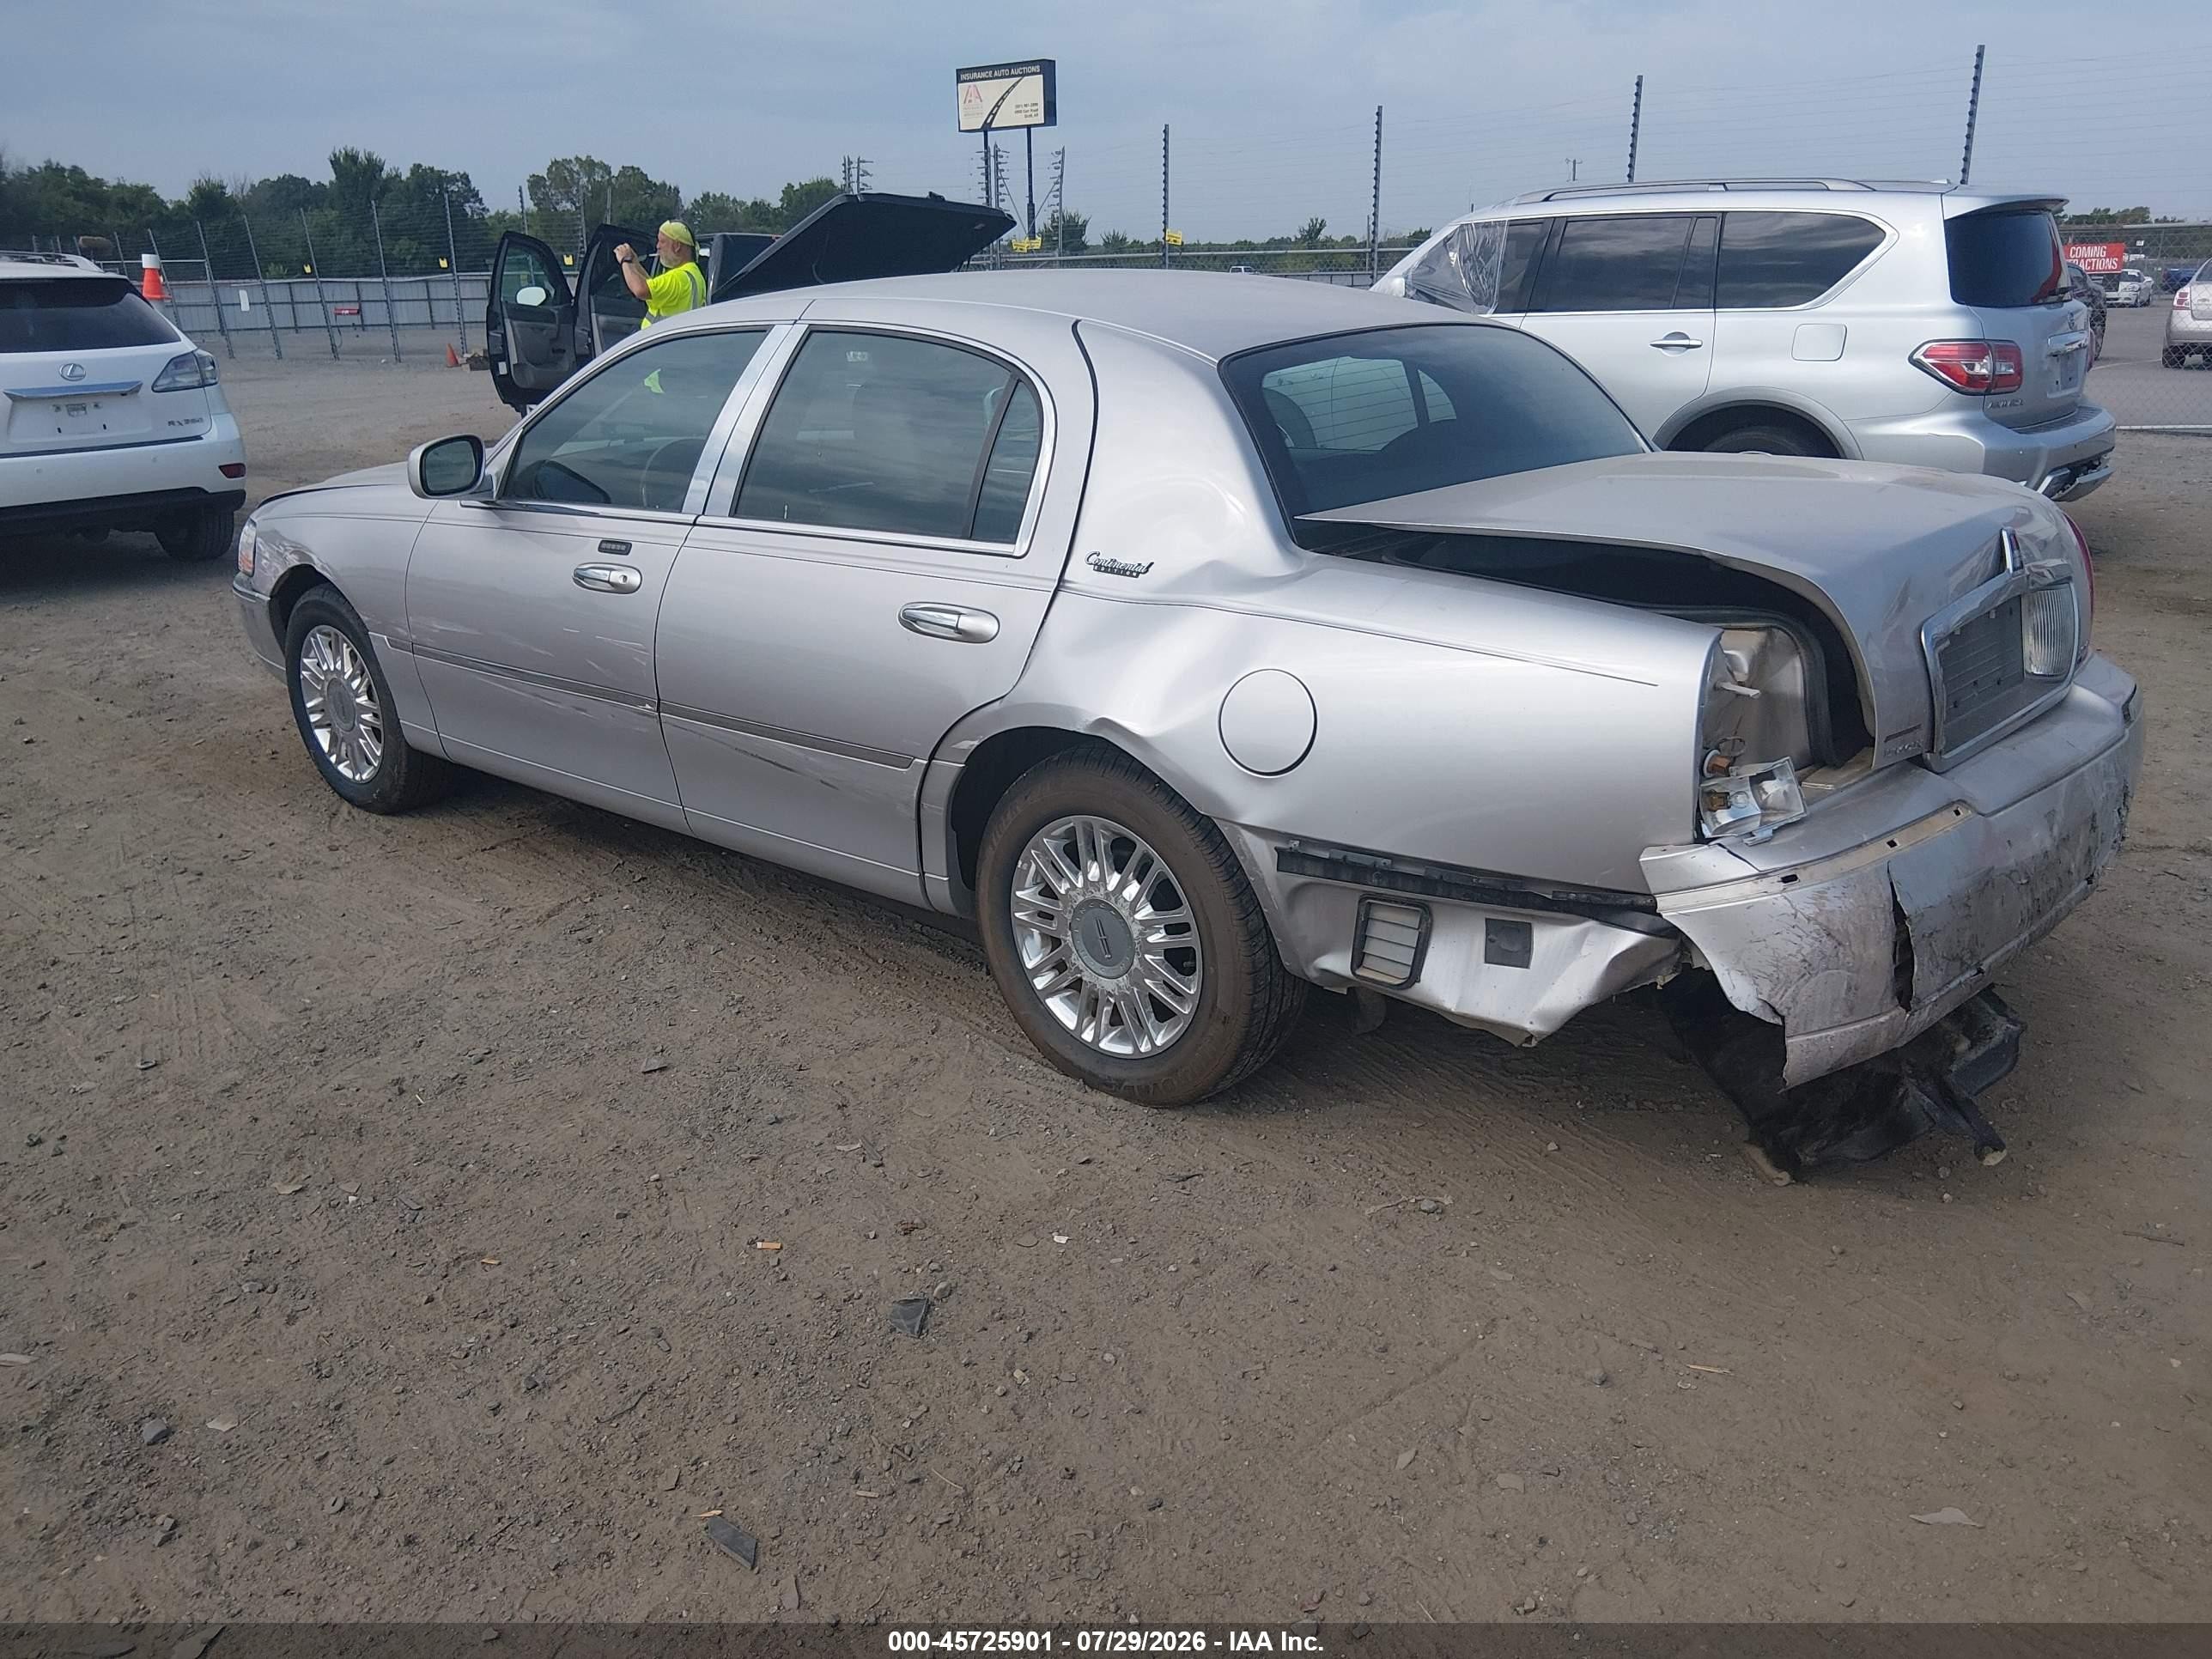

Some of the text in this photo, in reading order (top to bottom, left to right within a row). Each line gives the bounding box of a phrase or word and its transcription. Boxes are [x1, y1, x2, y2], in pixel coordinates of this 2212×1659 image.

[960, 64, 1041, 82] INSURANCE AUTO AUCTIONS
[2069, 246, 2107, 258] COMING
[1085, 550, 1155, 574] Continental
[1094, 565, 1138, 577] EDITION
